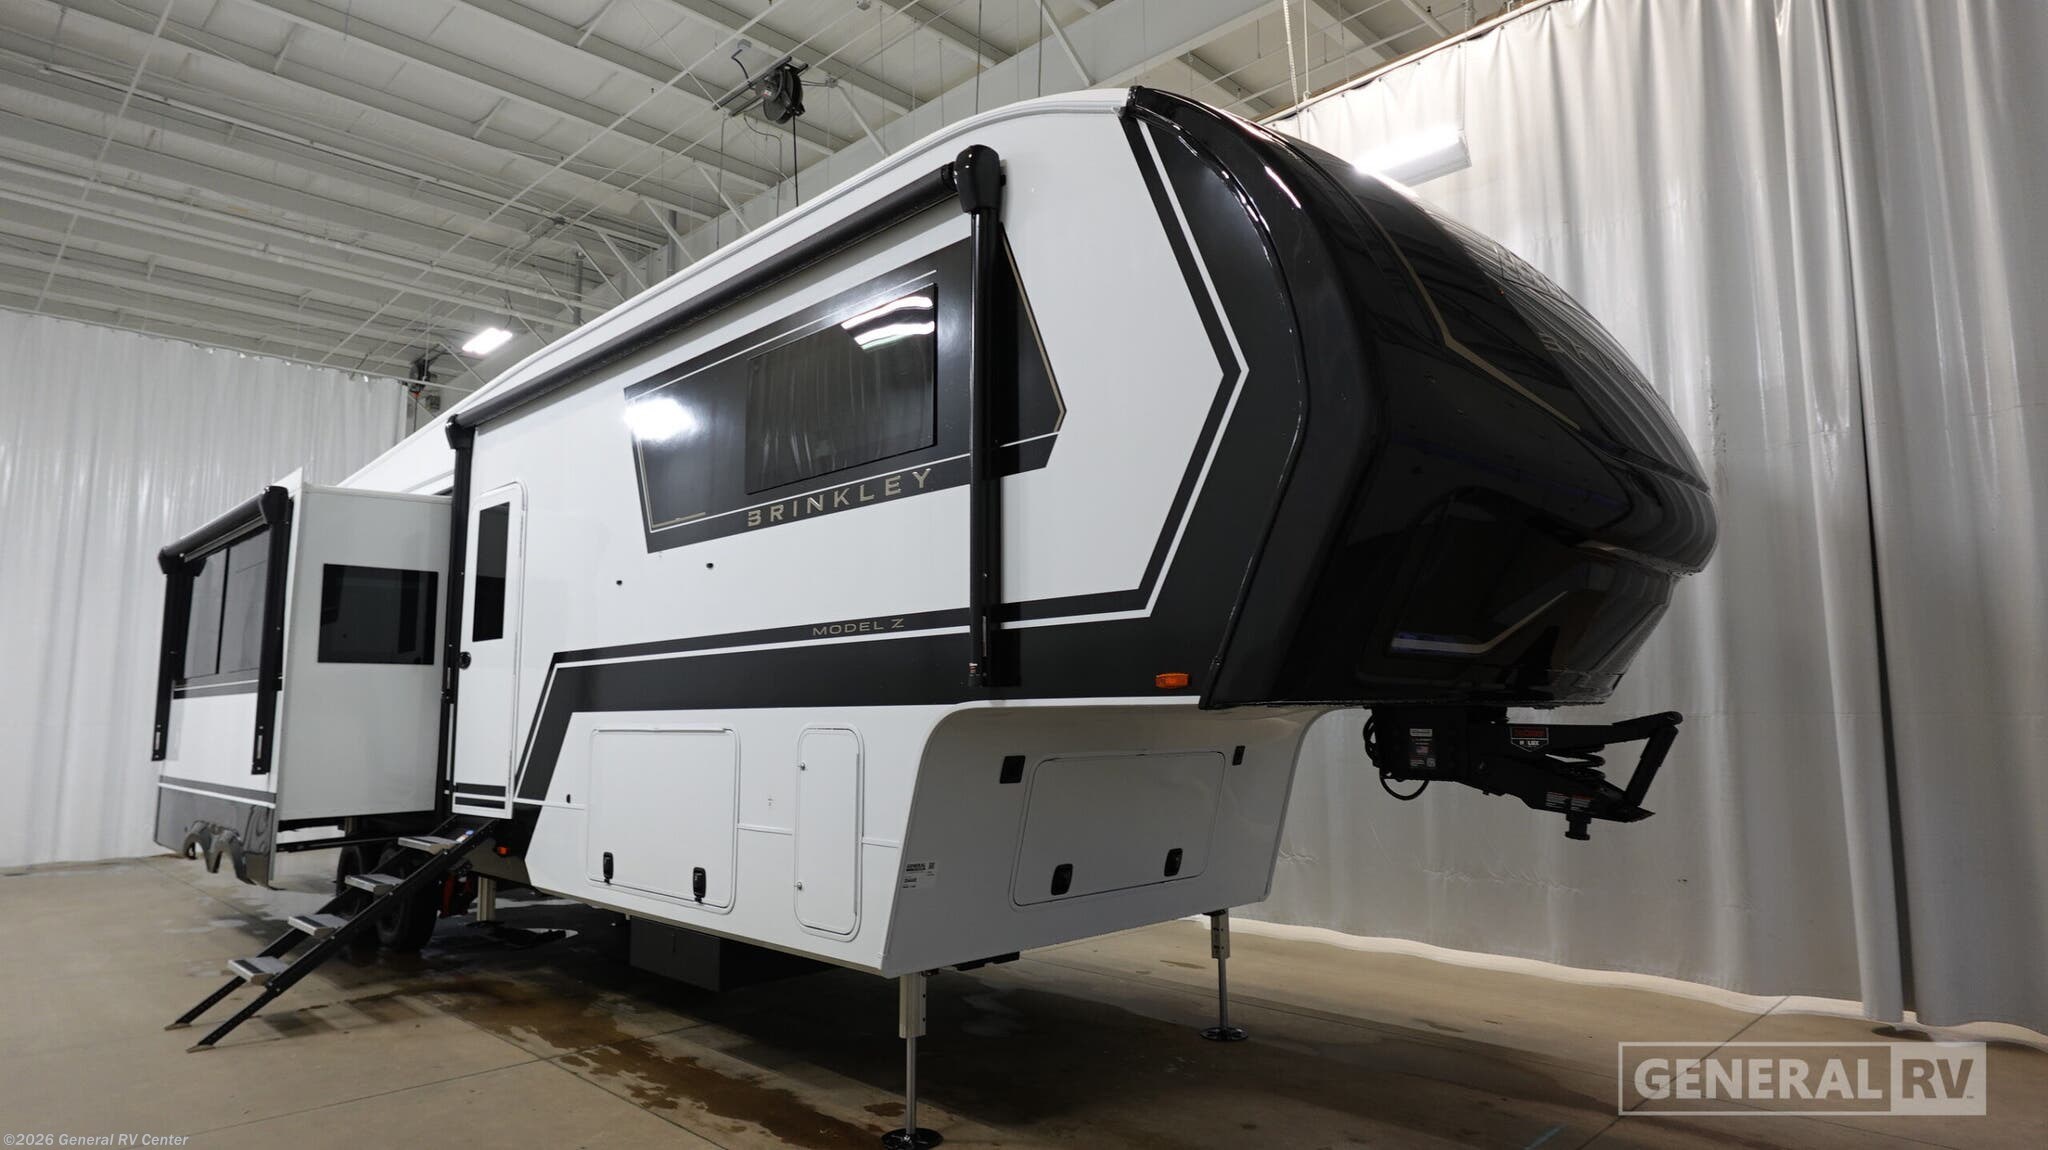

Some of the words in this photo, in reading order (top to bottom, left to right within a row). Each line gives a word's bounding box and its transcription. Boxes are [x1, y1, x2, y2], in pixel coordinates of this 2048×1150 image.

[747, 467, 932, 527] BRINKLEY
[812, 620, 884, 636] MODEL
[890, 617, 905, 629] Z
